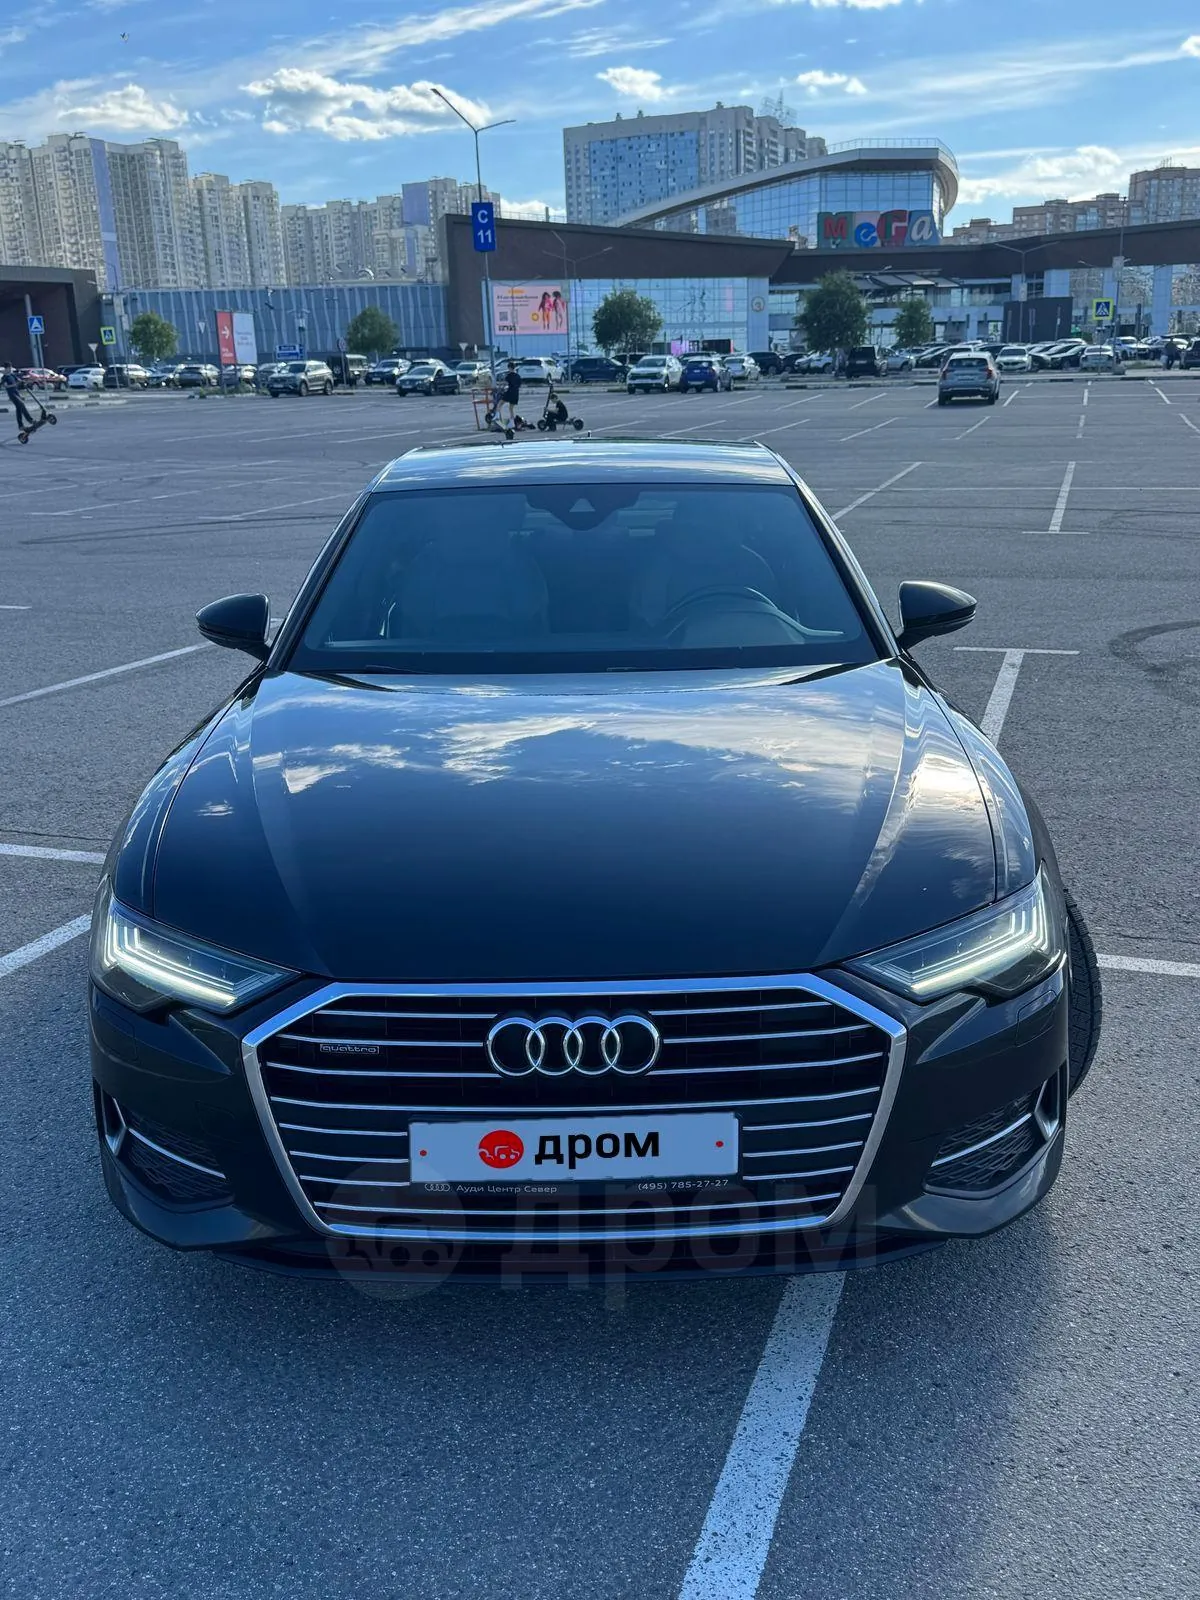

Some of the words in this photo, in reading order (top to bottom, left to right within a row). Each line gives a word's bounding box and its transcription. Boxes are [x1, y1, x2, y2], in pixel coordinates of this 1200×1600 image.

[477, 229, 493, 244] 11
[322, 1044, 377, 1053] quattro
[456, 1184, 484, 1194] Ауди
[487, 1185, 521, 1194] Центр
[524, 1185, 557, 1194] Север
[637, 1182, 667, 1191] (495)
[670, 1179, 729, 1189] 785-27-27
